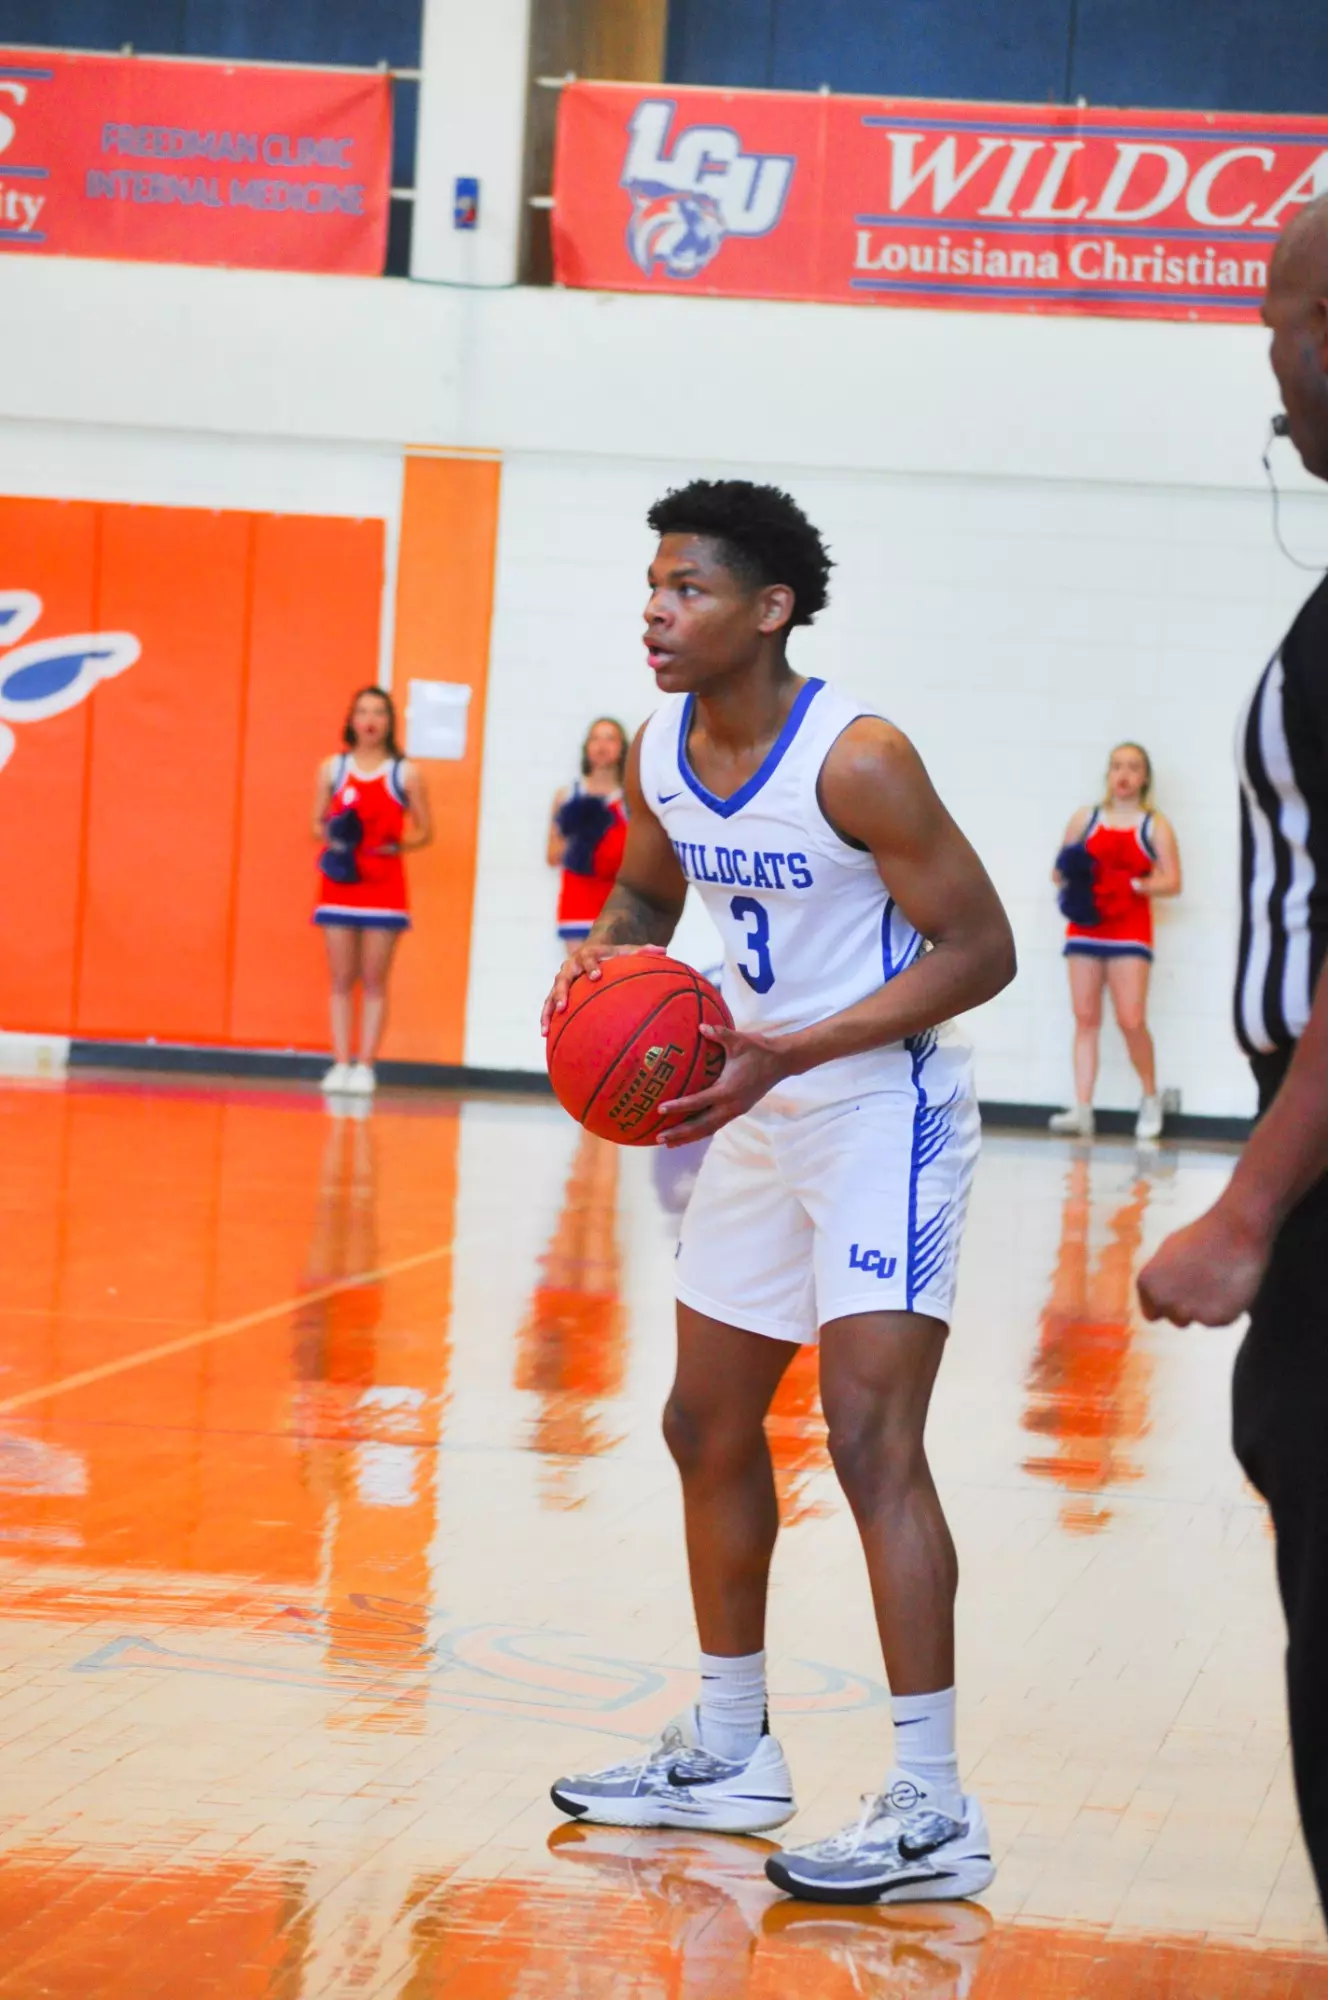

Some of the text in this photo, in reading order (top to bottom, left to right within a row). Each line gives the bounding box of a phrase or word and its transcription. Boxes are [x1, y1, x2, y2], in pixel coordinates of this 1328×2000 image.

[101, 122, 354, 169] FREEDMAN CLINIC
[620, 98, 797, 238] LCU
[86, 169, 365, 216] INTERNAL MEDICINE
[854, 230, 1267, 287] Louisiana Christian
[730, 895, 775, 994] 3
[619, 1043, 685, 1131] LEGACY
[849, 1243, 897, 1279] LCU
